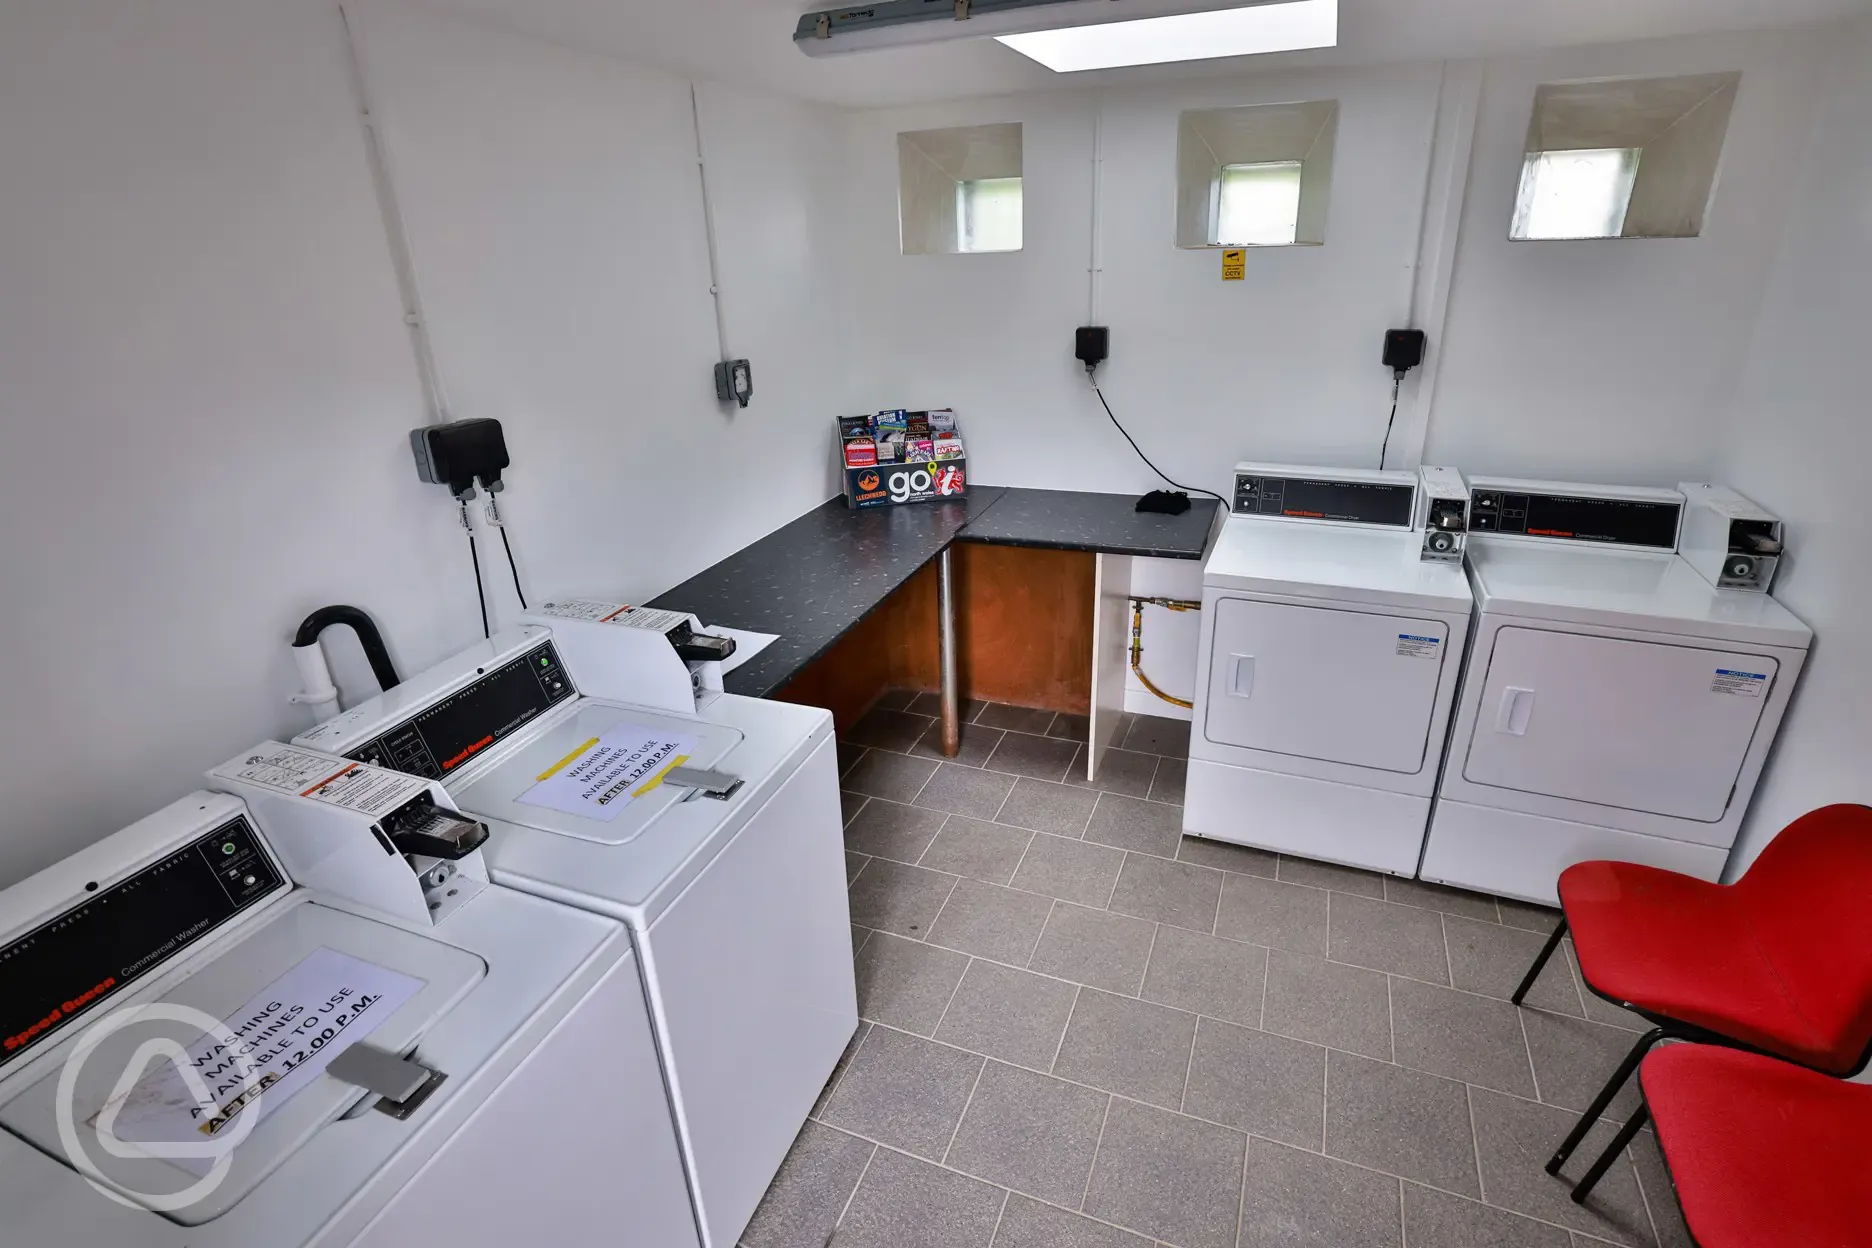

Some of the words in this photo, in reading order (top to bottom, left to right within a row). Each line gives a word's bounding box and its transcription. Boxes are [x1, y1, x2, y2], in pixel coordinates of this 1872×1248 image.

[889, 470, 931, 503] go
[1602, 534, 1617, 542] Dryer
[442, 748, 469, 770] Speed
[467, 734, 493, 753] Queen
[494, 717, 521, 737] Commercial
[519, 706, 538, 722] Washer
[566, 746, 611, 778] WASHING
[579, 748, 628, 783] MACHINES
[581, 763, 630, 800] AVAILABLE
[629, 752, 642, 764] TO
[640, 739, 658, 757] USE
[598, 779, 630, 805] AFTER
[629, 757, 656, 779] 12.00
[655, 742, 677, 760] P.M.
[51, 909, 90, 933] PRESS
[121, 880, 141, 895] ALL
[153, 852, 189, 875] FABRIC
[3, 1008, 62, 1050] Speed
[61, 976, 116, 1013] Queen
[120, 938, 177, 977] Commercial
[174, 916, 210, 943] Washer
[190, 1001, 283, 1068] WASHING
[190, 1037, 293, 1119] AVAILABLE
[291, 1016, 319, 1037] TO
[318, 987, 354, 1014] USE
[204, 1004, 305, 1079] MACHINES
[208, 1074, 277, 1134] AFTER
[281, 1027, 336, 1072] 12.00
[334, 993, 384, 1027] P.M.
